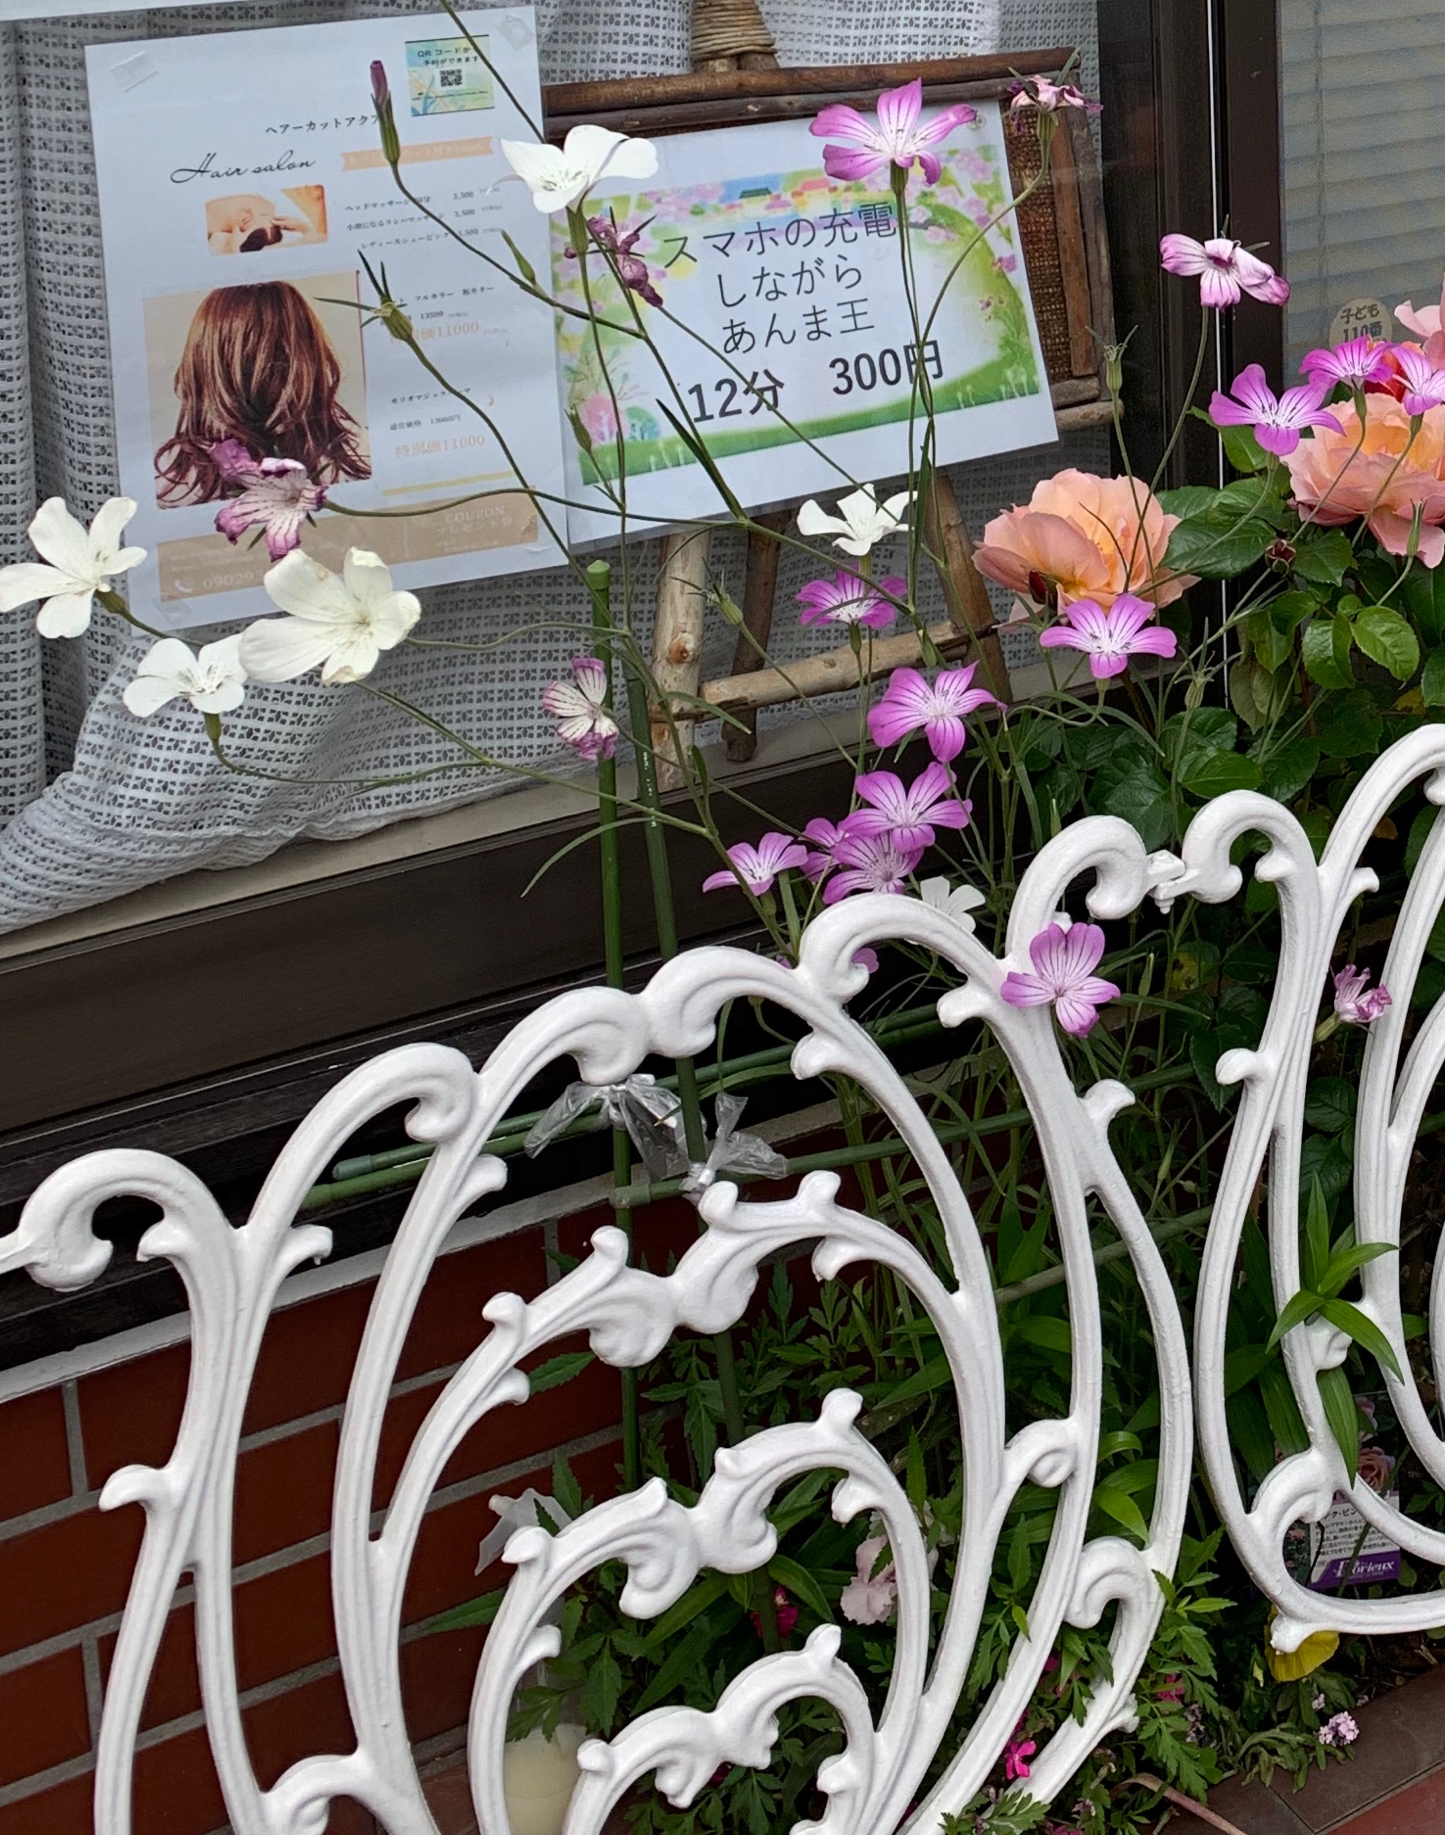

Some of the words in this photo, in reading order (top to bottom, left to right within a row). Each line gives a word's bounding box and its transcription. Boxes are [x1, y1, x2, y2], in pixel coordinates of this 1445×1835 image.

[417, 49, 432, 58] QR
[435, 47, 472, 56] コードか
[170, 151, 246, 184] Hair
[251, 150, 316, 175] salon
[662, 202, 899, 269] スマホの充電
[717, 255, 864, 308] しながら
[722, 297, 875, 355] あんま王
[687, 368, 785, 423] 12分
[828, 339, 944, 396] 300円
